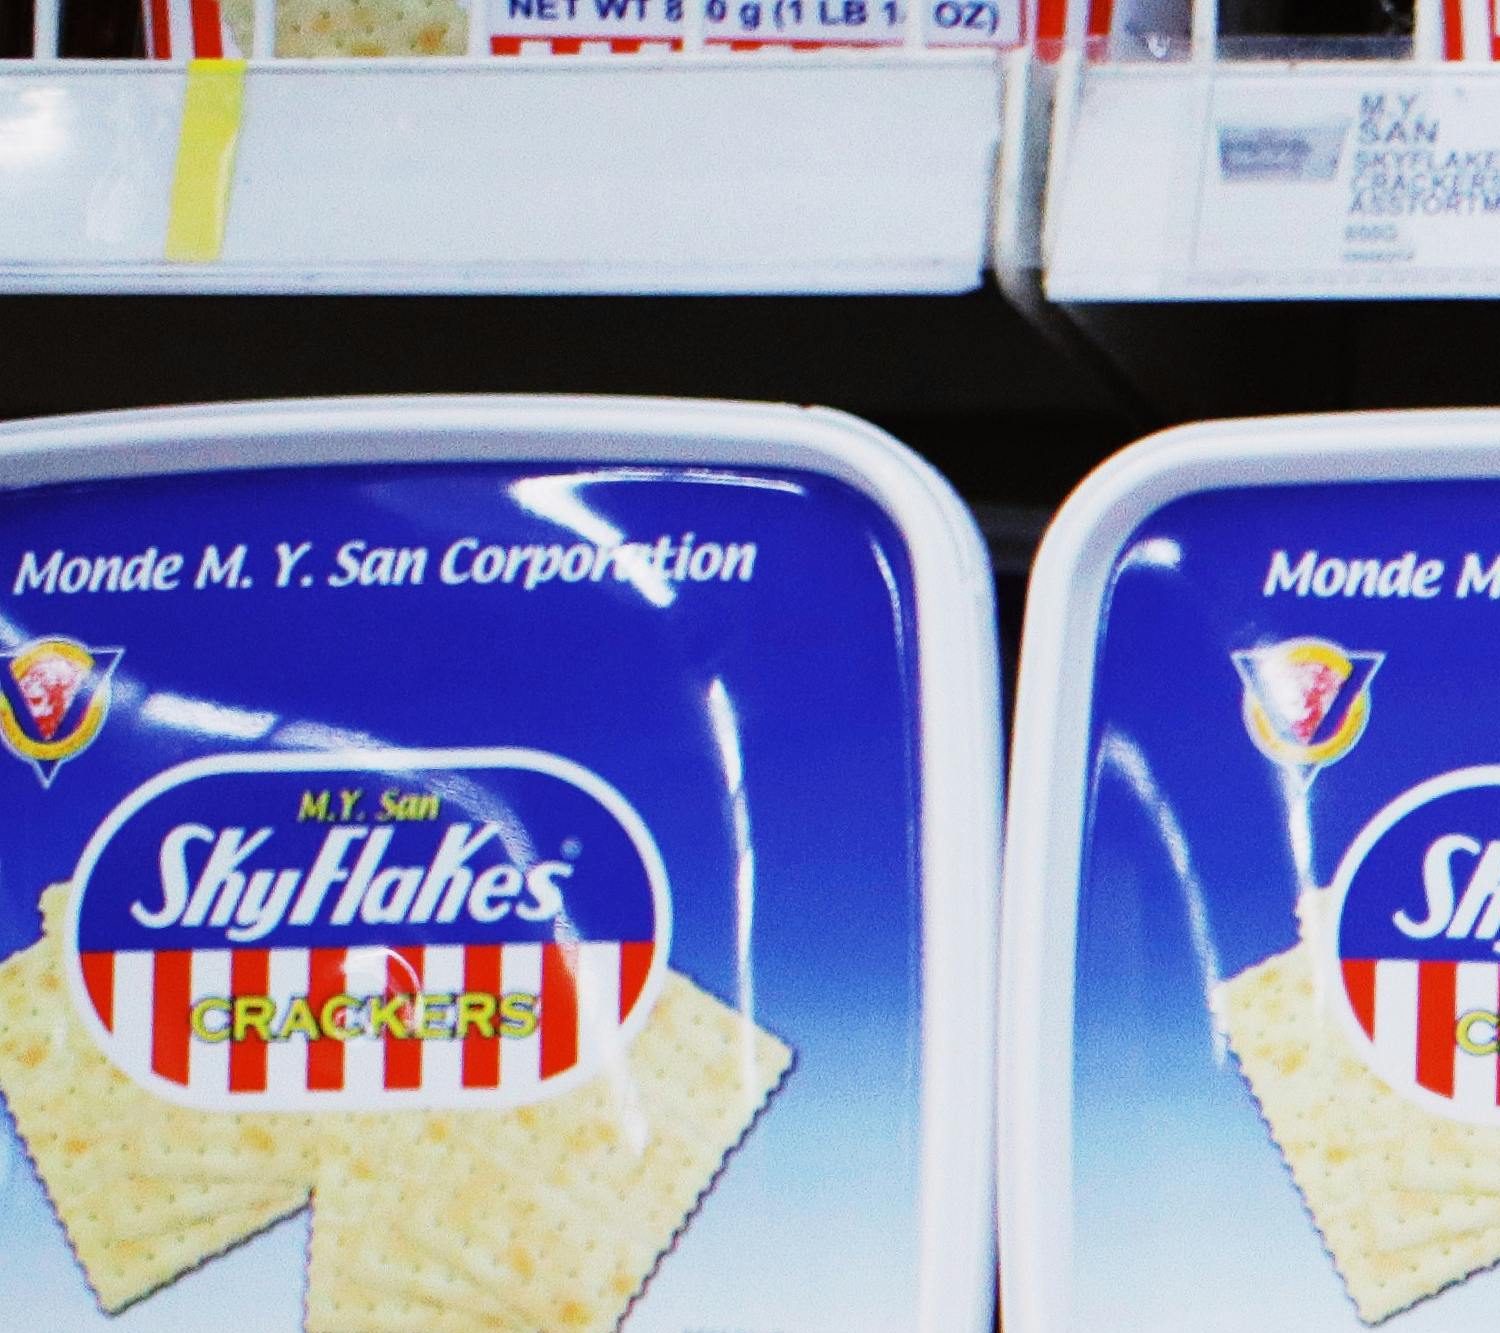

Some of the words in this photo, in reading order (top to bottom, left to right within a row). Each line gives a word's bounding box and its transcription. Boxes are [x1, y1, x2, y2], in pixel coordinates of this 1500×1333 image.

[1360, 117, 1437, 143] SAN
[14, 545, 181, 596] Monde
[195, 543, 255, 591] M.
[275, 541, 326, 588] Y.
[336, 538, 428, 589] San
[439, 534, 758, 592] Corporation
[1264, 549, 1444, 600] Monde
[131, 823, 574, 945] SkyFlakes
[191, 993, 541, 1045] CRACKERS
